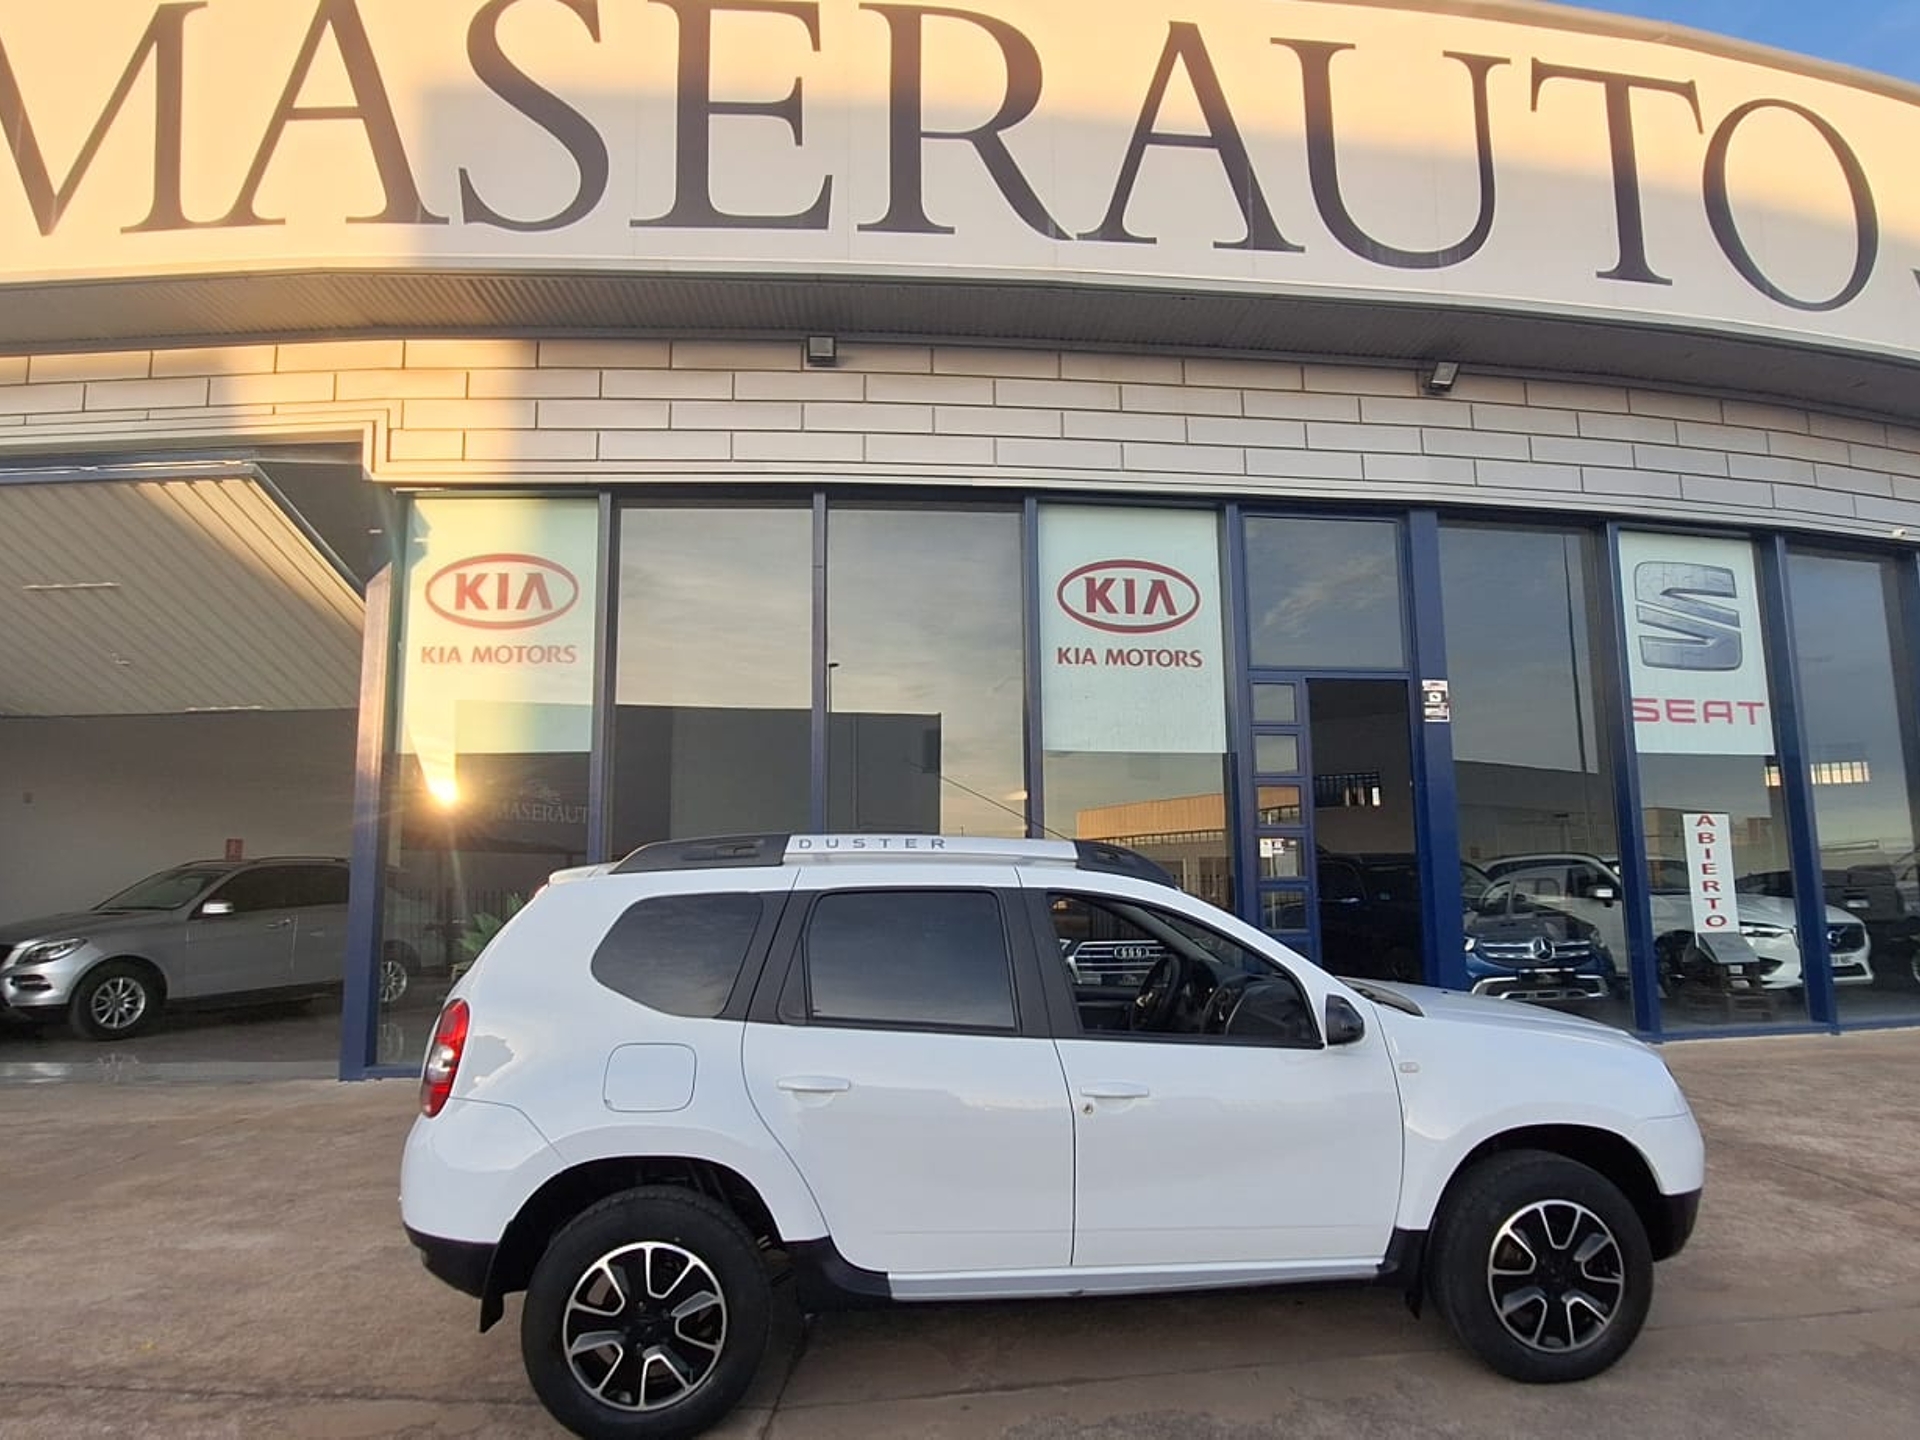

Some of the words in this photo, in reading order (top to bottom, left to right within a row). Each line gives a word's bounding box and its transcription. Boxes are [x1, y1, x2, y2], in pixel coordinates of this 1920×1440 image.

[0, 0, 1878, 311] MASERAUTO
[454, 572, 553, 611] KIA
[1084, 576, 1177, 616] KIA
[421, 645, 462, 664] KIA
[471, 645, 577, 665] MOTORS
[1057, 646, 1097, 665] KIA
[1105, 648, 1203, 668] MOTORS
[1632, 697, 1765, 725] SEAT
[798, 837, 946, 850] DUSTER
[1696, 814, 1727, 928] ABIERTO
